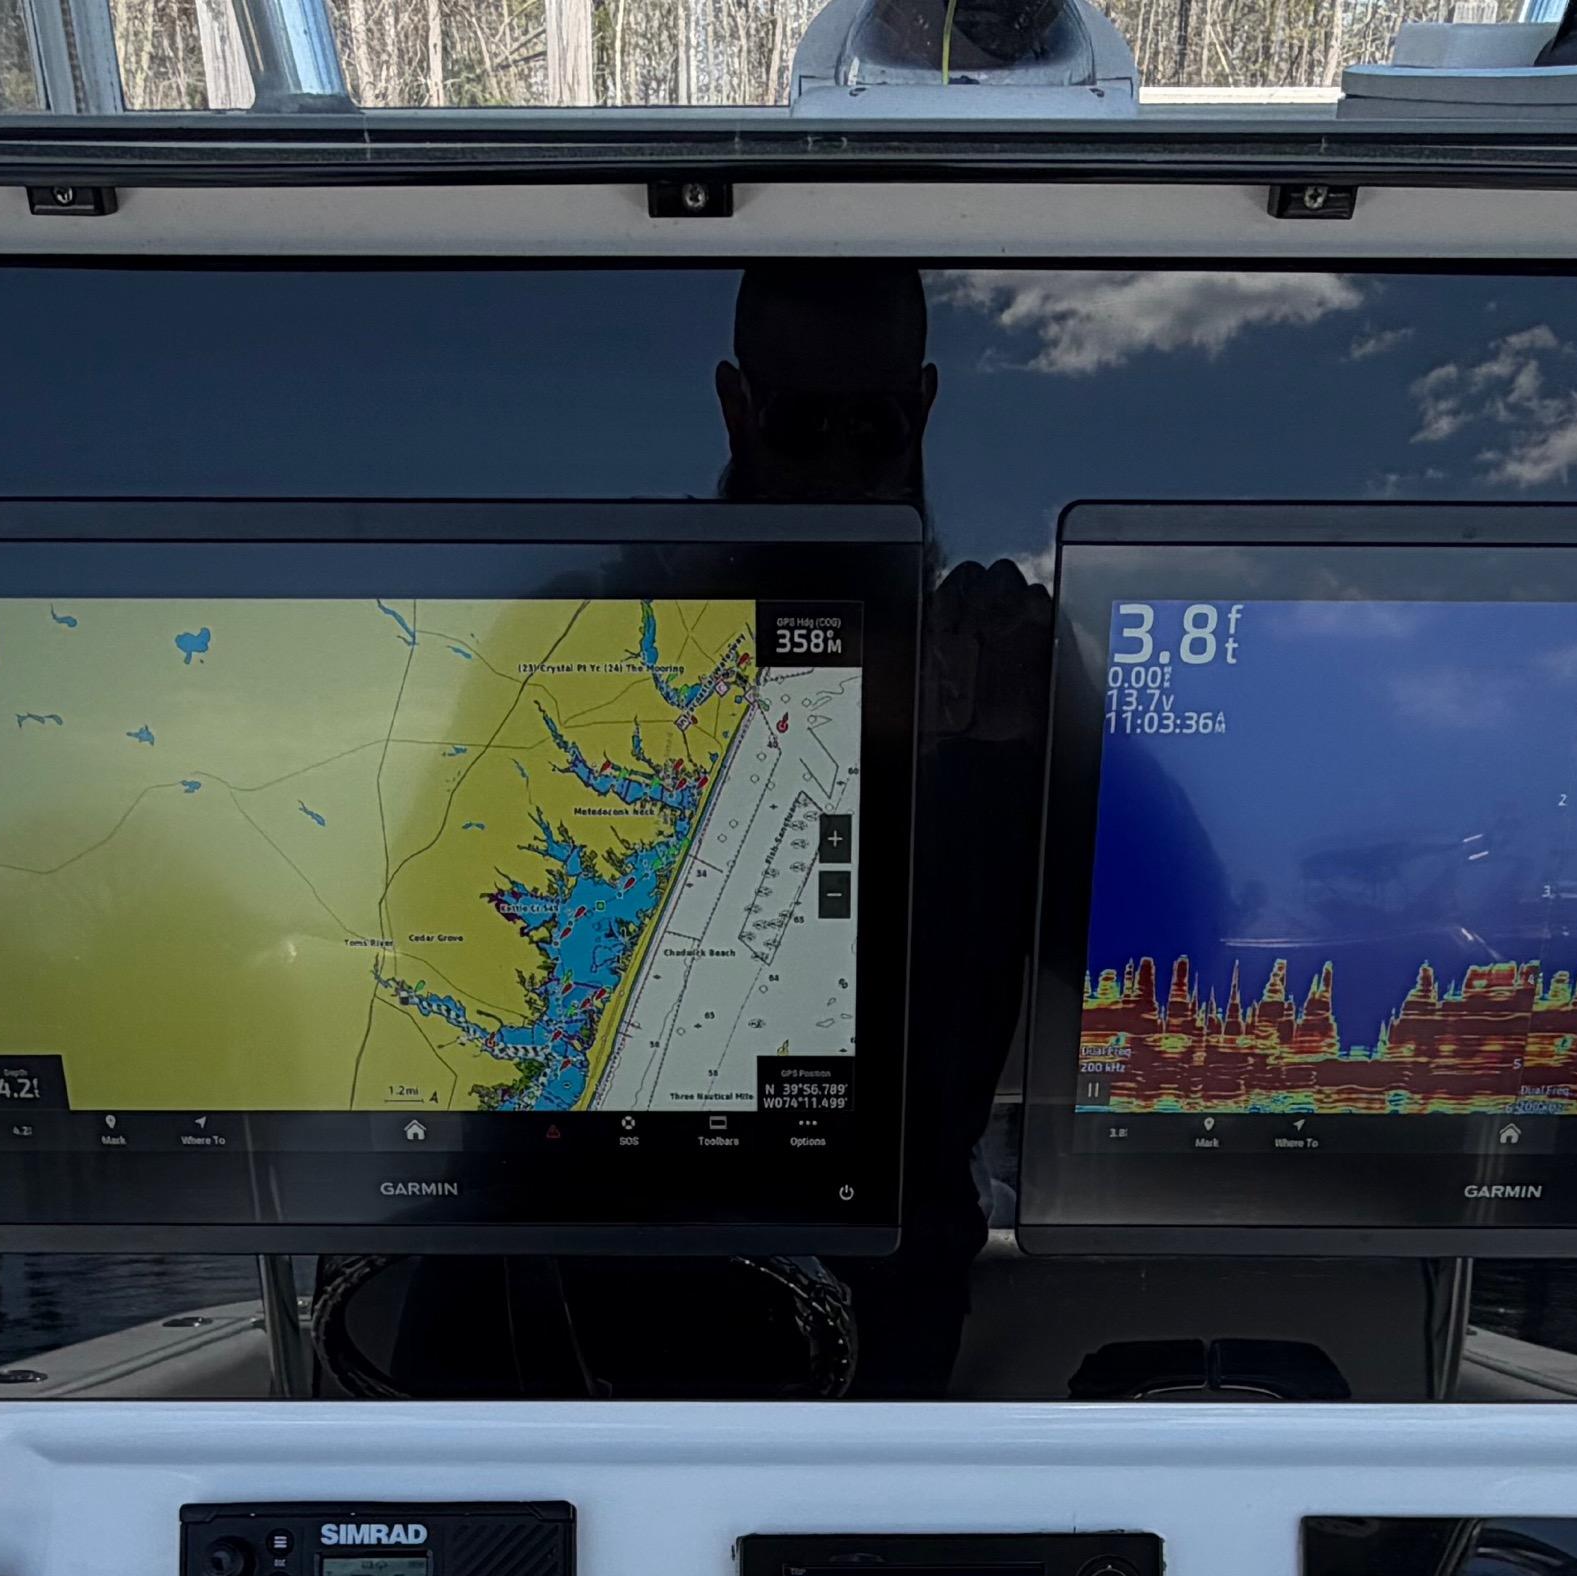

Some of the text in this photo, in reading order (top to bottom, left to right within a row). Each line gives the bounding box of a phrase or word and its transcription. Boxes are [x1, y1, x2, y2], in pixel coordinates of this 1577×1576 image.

[625, 663, 644, 674] The
[344, 938, 368, 947] Toms
[436, 933, 464, 943] Grove
[709, 948, 737, 958] Beach
[1080, 1063, 1103, 1074] 200
[669, 1092, 754, 1101] Three Nautical Mile
[180, 1135, 227, 1146] Where To
[619, 1136, 640, 1147] SOS
[697, 1136, 740, 1147] Toolbars
[789, 1136, 827, 1148] Options
[1194, 1138, 1220, 1148] Mark
[1274, 1138, 1319, 1148] Where To
[379, 1181, 459, 1197] GARMIN
[1463, 1184, 1543, 1199] GARMIN
[320, 1523, 428, 1546] SIMRAD
